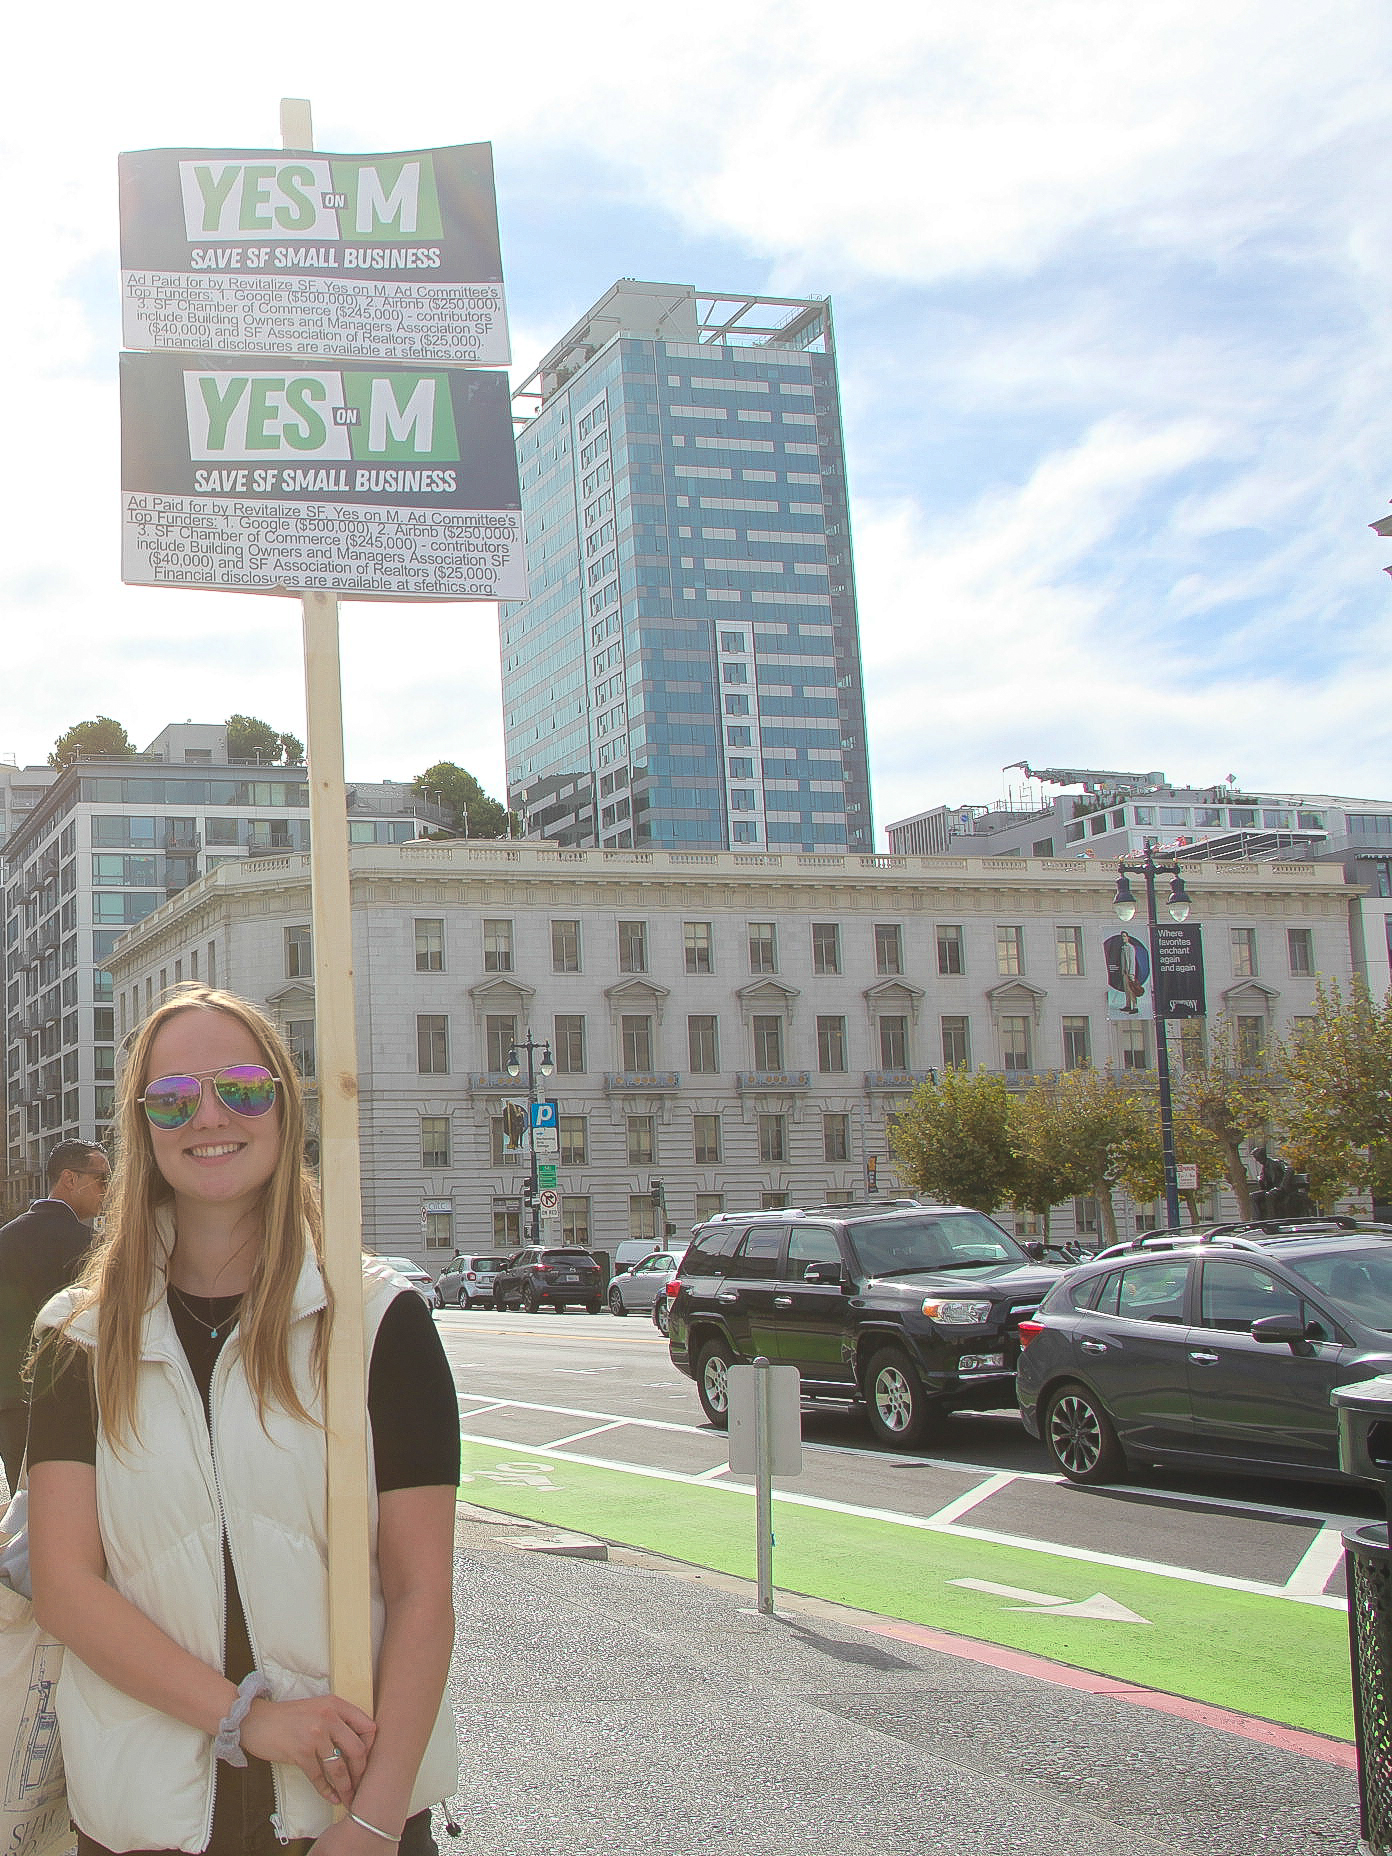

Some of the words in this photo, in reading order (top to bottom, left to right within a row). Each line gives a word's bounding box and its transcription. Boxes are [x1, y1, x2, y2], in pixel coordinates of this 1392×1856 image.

[194, 166, 315, 232] YES
[325, 194, 345, 208] ON
[357, 162, 420, 233] M
[191, 247, 241, 269] SAVE
[247, 248, 272, 268] SF
[275, 248, 339, 268] SMALL
[344, 248, 441, 269] BUSINESS
[154, 335, 212, 348] Financial
[217, 338, 292, 352] disclosures
[296, 344, 318, 352] are
[322, 342, 380, 355] available
[384, 346, 397, 356] at
[400, 345, 480, 362] sfethics.org.
[198, 377, 327, 451] YES
[336, 409, 358, 424] ON
[368, 378, 436, 452] M
[194, 470, 247, 493] SAVE
[253, 470, 277, 491] SF
[282, 470, 350, 492] SMALL
[355, 470, 457, 493] BUSINESS
[128, 495, 146, 508] Ad
[152, 497, 183, 511] Paid
[189, 499, 206, 512] for
[212, 501, 227, 515] by
[233, 502, 300, 517] Revitalize
[333, 507, 358, 520] Yes
[363, 512, 381, 521] on
[407, 511, 426, 523] Ad
[129, 510, 152, 524] Top
[157, 512, 216, 527] Funders:
[222, 516, 233, 527] 1.
[239, 517, 289, 532] Google
[377, 524, 389, 535] 2.
[394, 524, 438, 537] Airbnb
[137, 523, 149, 536] 3.
[155, 525, 173, 537] SF
[179, 526, 242, 541] Chamber
[247, 529, 259, 542] of
[265, 530, 340, 546] Commerce
[430, 539, 509, 554] contributors
[137, 537, 184, 552] include
[190, 541, 242, 558] Building
[248, 543, 301, 558] Owners
[306, 546, 331, 559] and
[337, 548, 404, 565] Managers
[409, 551, 485, 566] Association
[490, 554, 510, 567] SF
[218, 556, 243, 569] and
[249, 558, 268, 570] SF
[272, 558, 351, 574] Association
[356, 562, 369, 575] of
[373, 563, 429, 577] Realtors
[154, 566, 216, 581] Financial
[221, 569, 299, 585] disclosures
[304, 577, 328, 586] are
[331, 574, 392, 589] available
[396, 579, 410, 590] at
[413, 578, 496, 596] sfethics.org.
[1159, 947, 1190, 955] enchant
